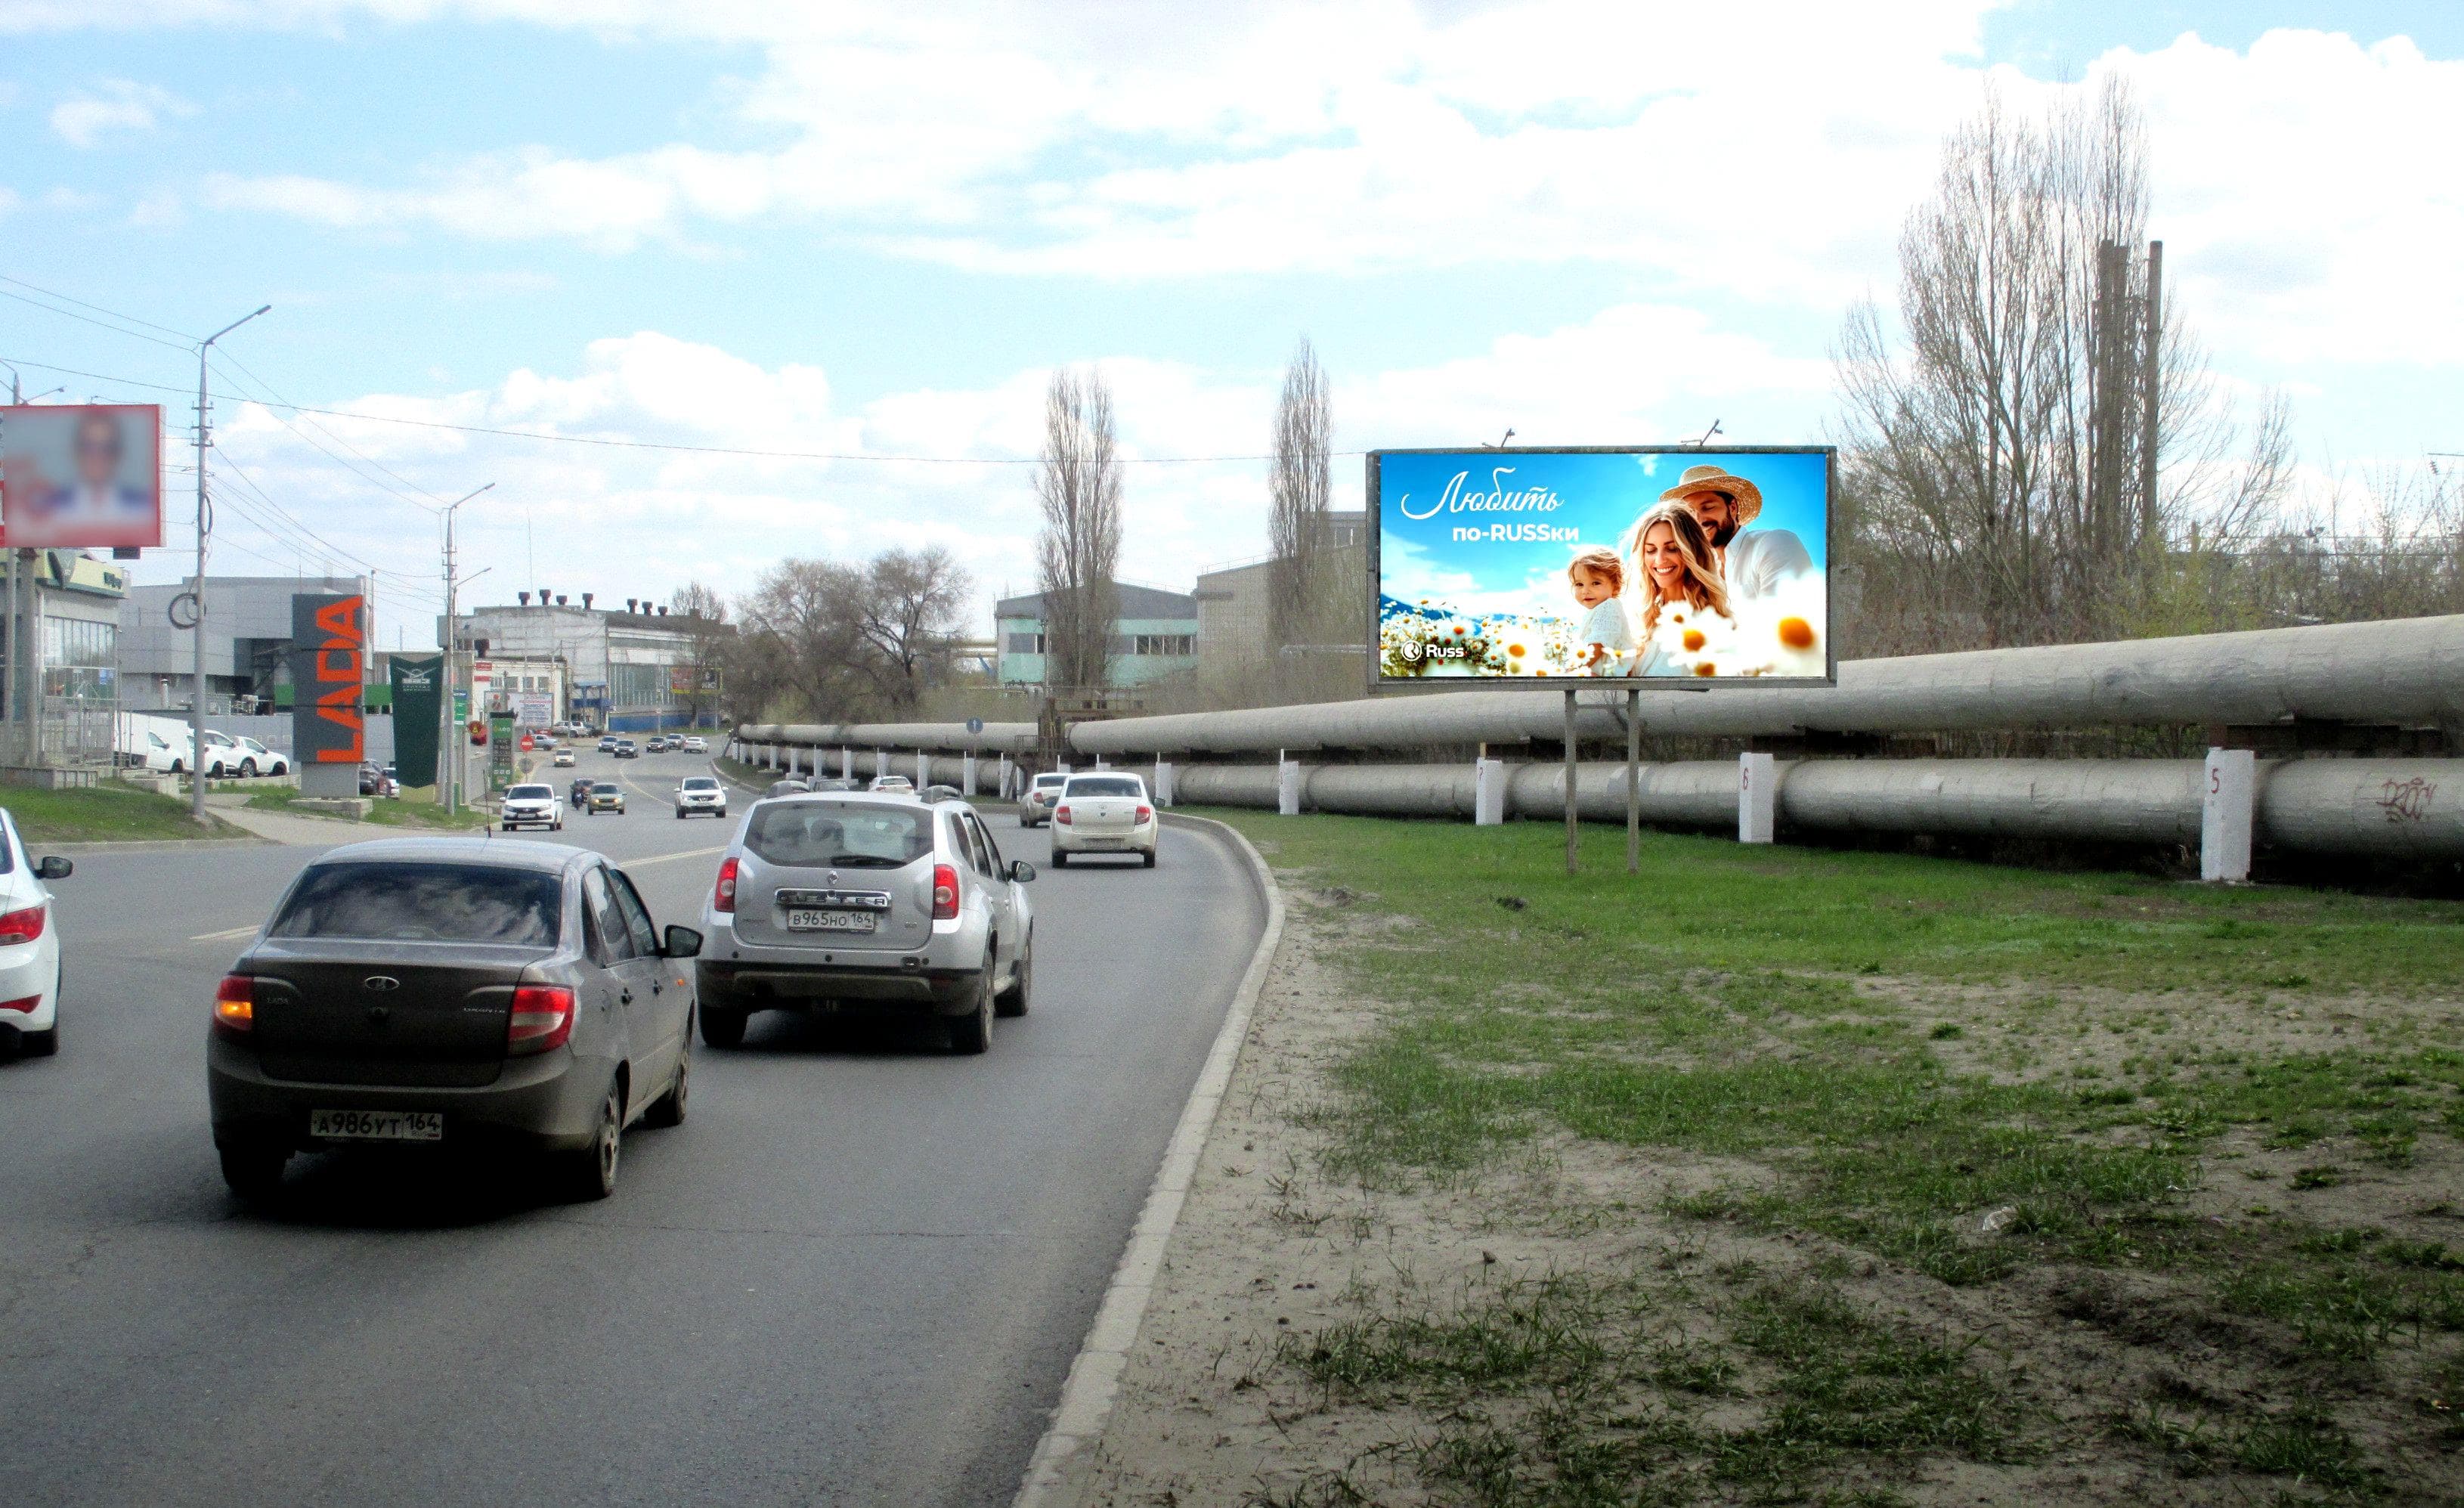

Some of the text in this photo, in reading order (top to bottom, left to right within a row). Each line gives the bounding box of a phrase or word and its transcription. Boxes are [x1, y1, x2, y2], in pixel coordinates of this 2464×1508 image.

[1401, 467, 1564, 520] Любить
[1453, 524, 1580, 542] по-RUSSки
[1425, 644, 1464, 658] Russ
[316, 596, 363, 762] LADA
[1743, 767, 1749, 791] 6
[2212, 768, 2220, 794] 5
[850, 912, 871, 923] 164
[405, 1114, 440, 1131] 164
